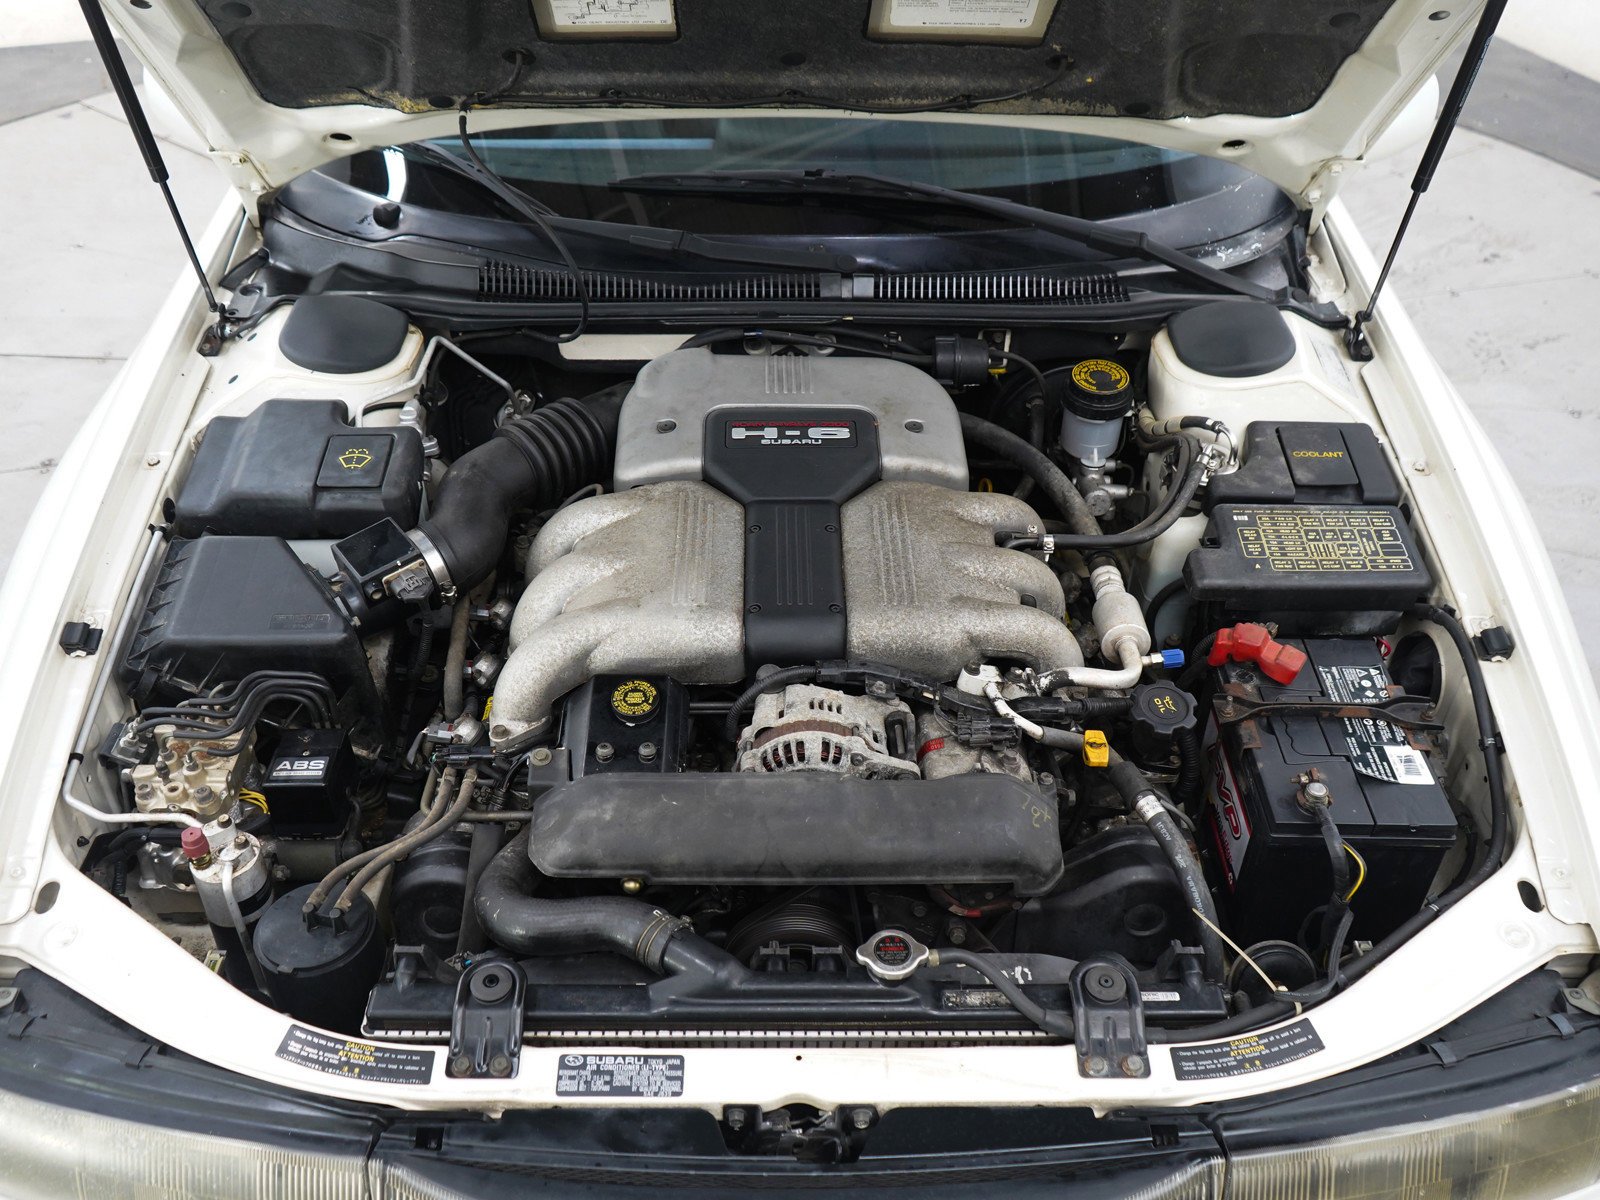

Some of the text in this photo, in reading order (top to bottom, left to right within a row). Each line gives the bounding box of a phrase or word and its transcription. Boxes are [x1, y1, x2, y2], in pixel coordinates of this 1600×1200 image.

[1154, 698, 1166, 714] OIL
[275, 760, 325, 770] ABS
[1230, 1036, 1259, 1046] CAUTION
[346, 1042, 376, 1052] CAUTION
[1230, 1044, 1265, 1057] ATTENTION
[338, 1050, 375, 1062] ATTENTION
[587, 1056, 644, 1065] SUBARU
